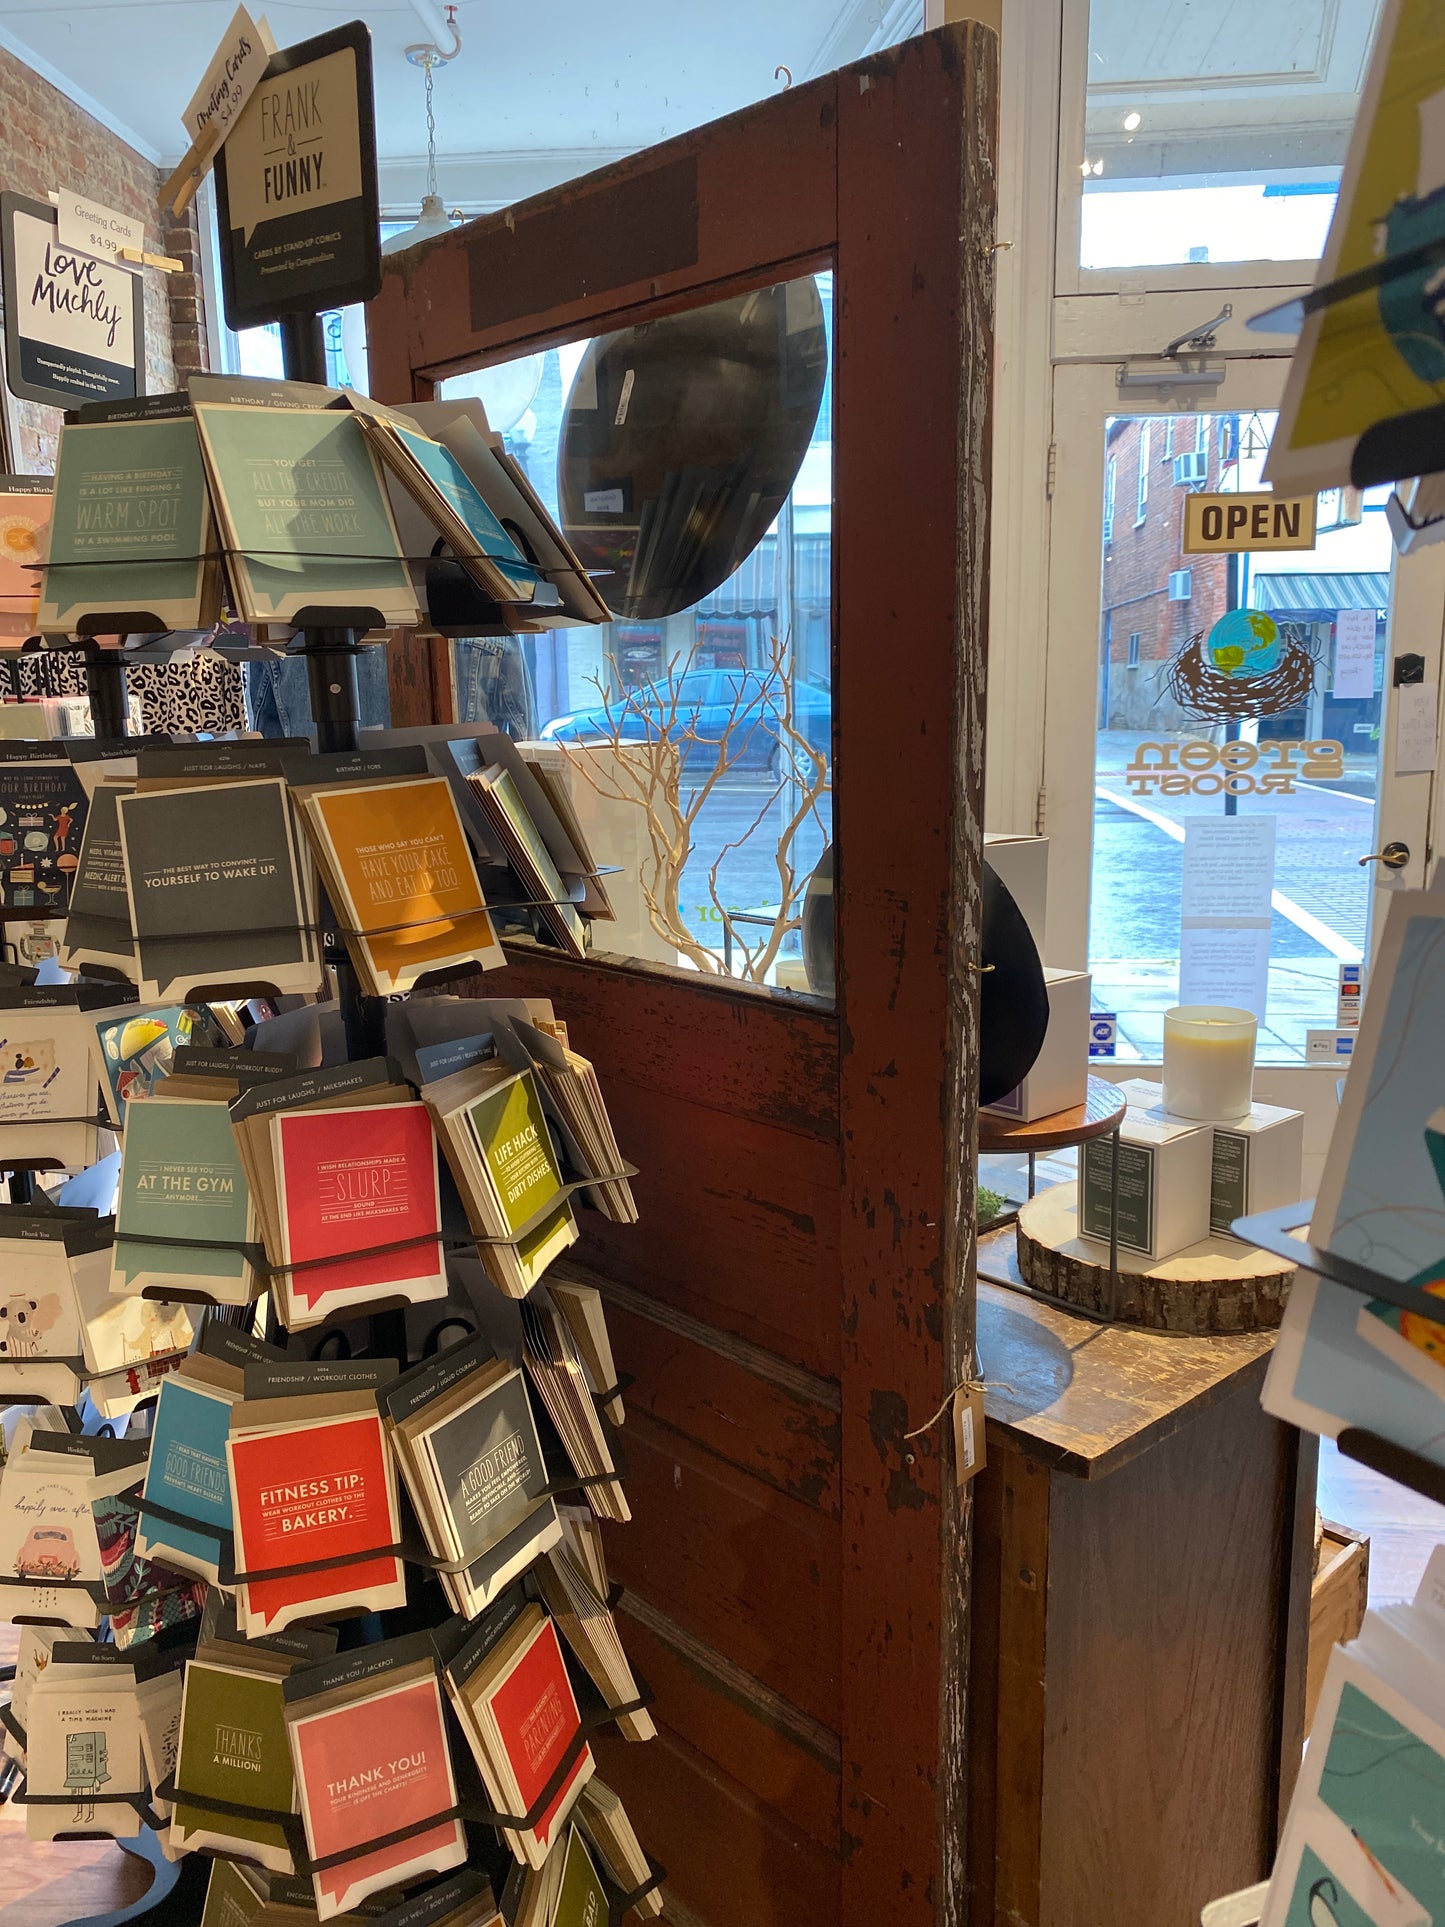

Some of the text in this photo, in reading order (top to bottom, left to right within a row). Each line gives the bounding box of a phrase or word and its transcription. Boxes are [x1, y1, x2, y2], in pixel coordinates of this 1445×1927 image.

[221, 84, 243, 127] $4.99
[262, 80, 323, 142] FRANK
[287, 134, 297, 156] &
[75, 205, 132, 238] Greeting Cards
[90, 234, 117, 252] $4.99
[254, 232, 341, 259] CARDS BY STAND-UP COMICS
[45, 242, 103, 287] Love
[32, 273, 122, 347] Muchly
[107, 405, 181, 421] BIRTHDAY SWIMMING
[230, 397, 300, 409] BIRTHDAY GIVING
[273, 459, 317, 468] YOU GET
[91, 473, 124, 481] HAVING
[134, 471, 173, 479] BIRTHDAY
[253, 472, 350, 492] ALL THE CREDIT
[98, 487, 114, 495] LOT
[135, 484, 172, 492] FINDING
[77, 498, 181, 530] WARM SPOT
[257, 499, 277, 508] BUT
[279, 499, 306, 507] YOUR
[309, 499, 336, 507] MOM
[265, 513, 290, 534] ALL
[296, 513, 320, 533] THE
[1202, 503, 1301, 541] OPEN
[74, 535, 147, 545] IN A SWIMMING
[6, 752, 58, 761] Happy Birthday
[183, 764, 199, 772] JUST
[214, 763, 242, 771] LAUGHS
[24, 783, 67, 793] BIRTHDAY
[355, 834, 445, 854] THOSE WHO SAY YOU CAN'T
[163, 866, 176, 875] THE
[176, 865, 192, 873] BEST
[193, 863, 209, 871] WAY
[221, 858, 257, 869] CONVINCE
[360, 847, 453, 879] HAVE YOUR CAKE
[144, 874, 201, 888] YOURSELF
[204, 871, 220, 881] TO
[222, 867, 257, 880] WAKE
[368, 879, 394, 901] AND
[398, 875, 418, 897] EAT
[421, 872, 431, 891] IT
[23, 998, 58, 1006] Friendship
[209, 1062, 230, 1070] LAUGHS
[236, 1064, 264, 1072] WORKOUT
[264, 1065, 283, 1074] BUDDY
[255, 1076, 363, 1109] JUST FOR LAUGHS MILKSHAKES
[338, 1159, 382, 1169] RELATIONSHIPS
[494, 1141, 514, 1166] LIFE
[137, 1175, 234, 1193] AT THE GYM
[337, 1169, 391, 1200] SLURP
[507, 1179, 527, 1204] DIRTY
[354, 1201, 375, 1209] SOUND
[366, 1207, 399, 1216] MILKSHAKES
[268, 1375, 305, 1384] FRIENDSHIP
[313, 1374, 348, 1382] WORKOUT
[410, 1358, 478, 1405] FRIENDSHIP LIQUID COURAGE
[166, 1453, 226, 1493] GOOD FRIENDS
[461, 1435, 525, 1499] A GOOD FRIEND
[260, 1475, 365, 1506] FITNESS TIP:
[14, 1495, 46, 1518] happily
[72, 1502, 91, 1519] after
[262, 1492, 365, 1518] WEAR WORKOUT CLOTHES TO THE
[282, 1506, 353, 1533] BAKERY.
[323, 1658, 394, 1686] THANK YOU JACKPOT
[215, 1728, 262, 1760] THANKS
[213, 1755, 261, 1773] A MILLION!
[327, 1751, 426, 1797] THANK YOU!
[330, 1796, 347, 1806] YOUR
[348, 1785, 377, 1799] KINDNESS
[392, 1766, 427, 1783] GENEROSITY
